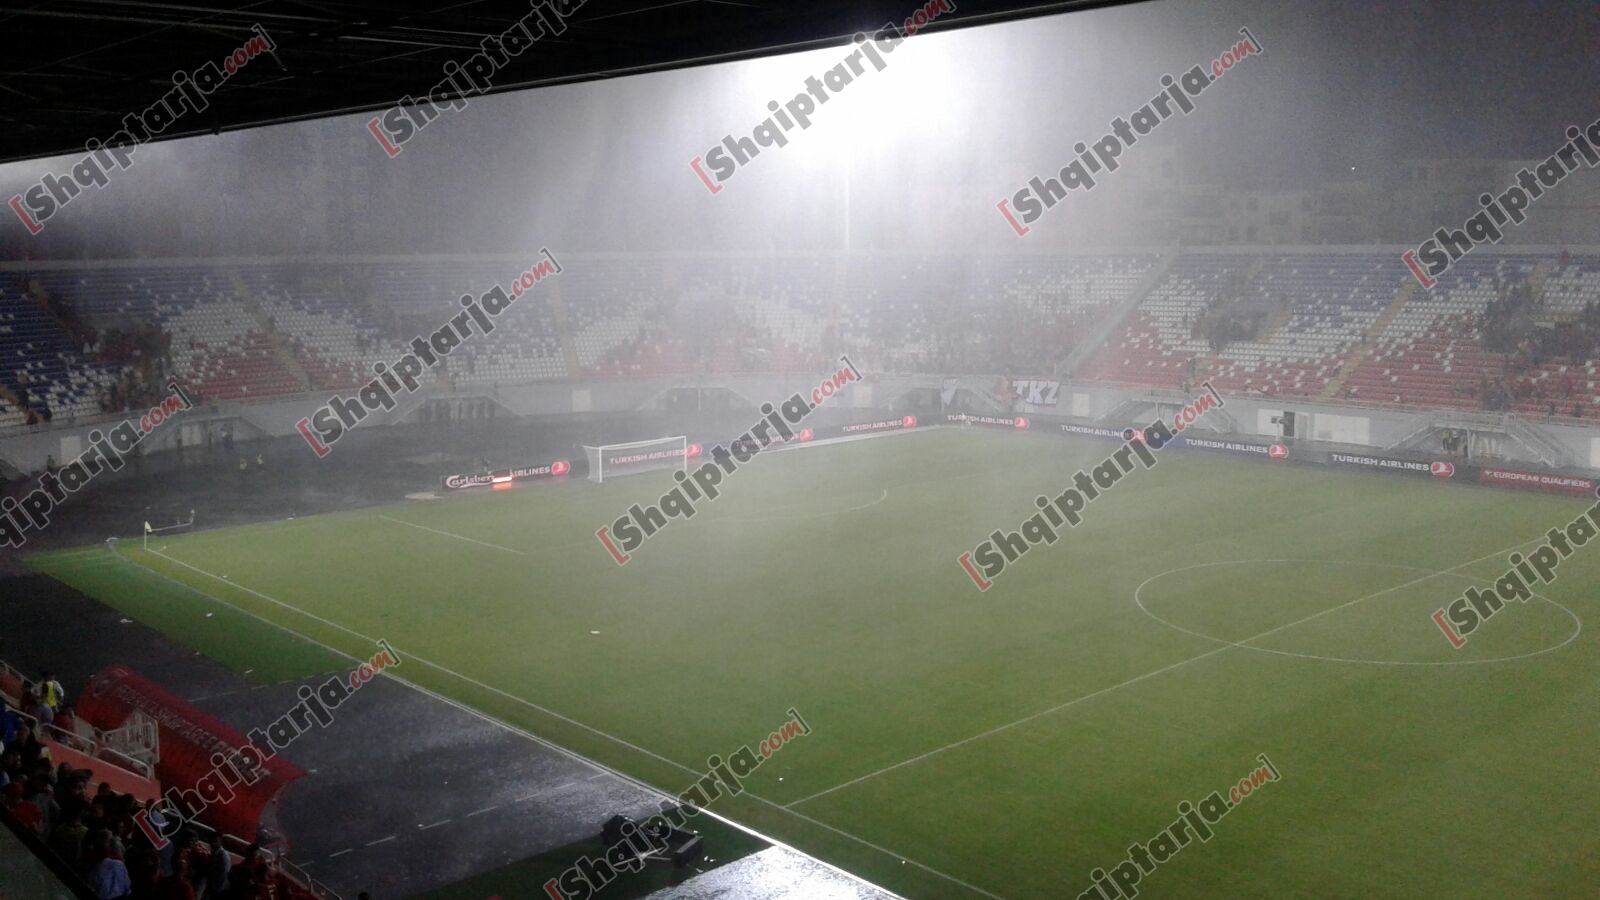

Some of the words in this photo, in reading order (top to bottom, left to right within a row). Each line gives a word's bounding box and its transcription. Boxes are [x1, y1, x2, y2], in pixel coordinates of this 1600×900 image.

[1061, 424, 1094, 434] TURKISH
[1185, 438, 1224, 449] TURKISH
[1226, 443, 1268, 453] AIRLINES
[609, 454, 648, 464] TURKISH
[1332, 454, 1378, 465] TURKISH
[1379, 460, 1430, 471] AIRLINES
[1493, 471, 1539, 481] EUROPEAN
[1541, 476, 1591, 488] QUALIFIERS
